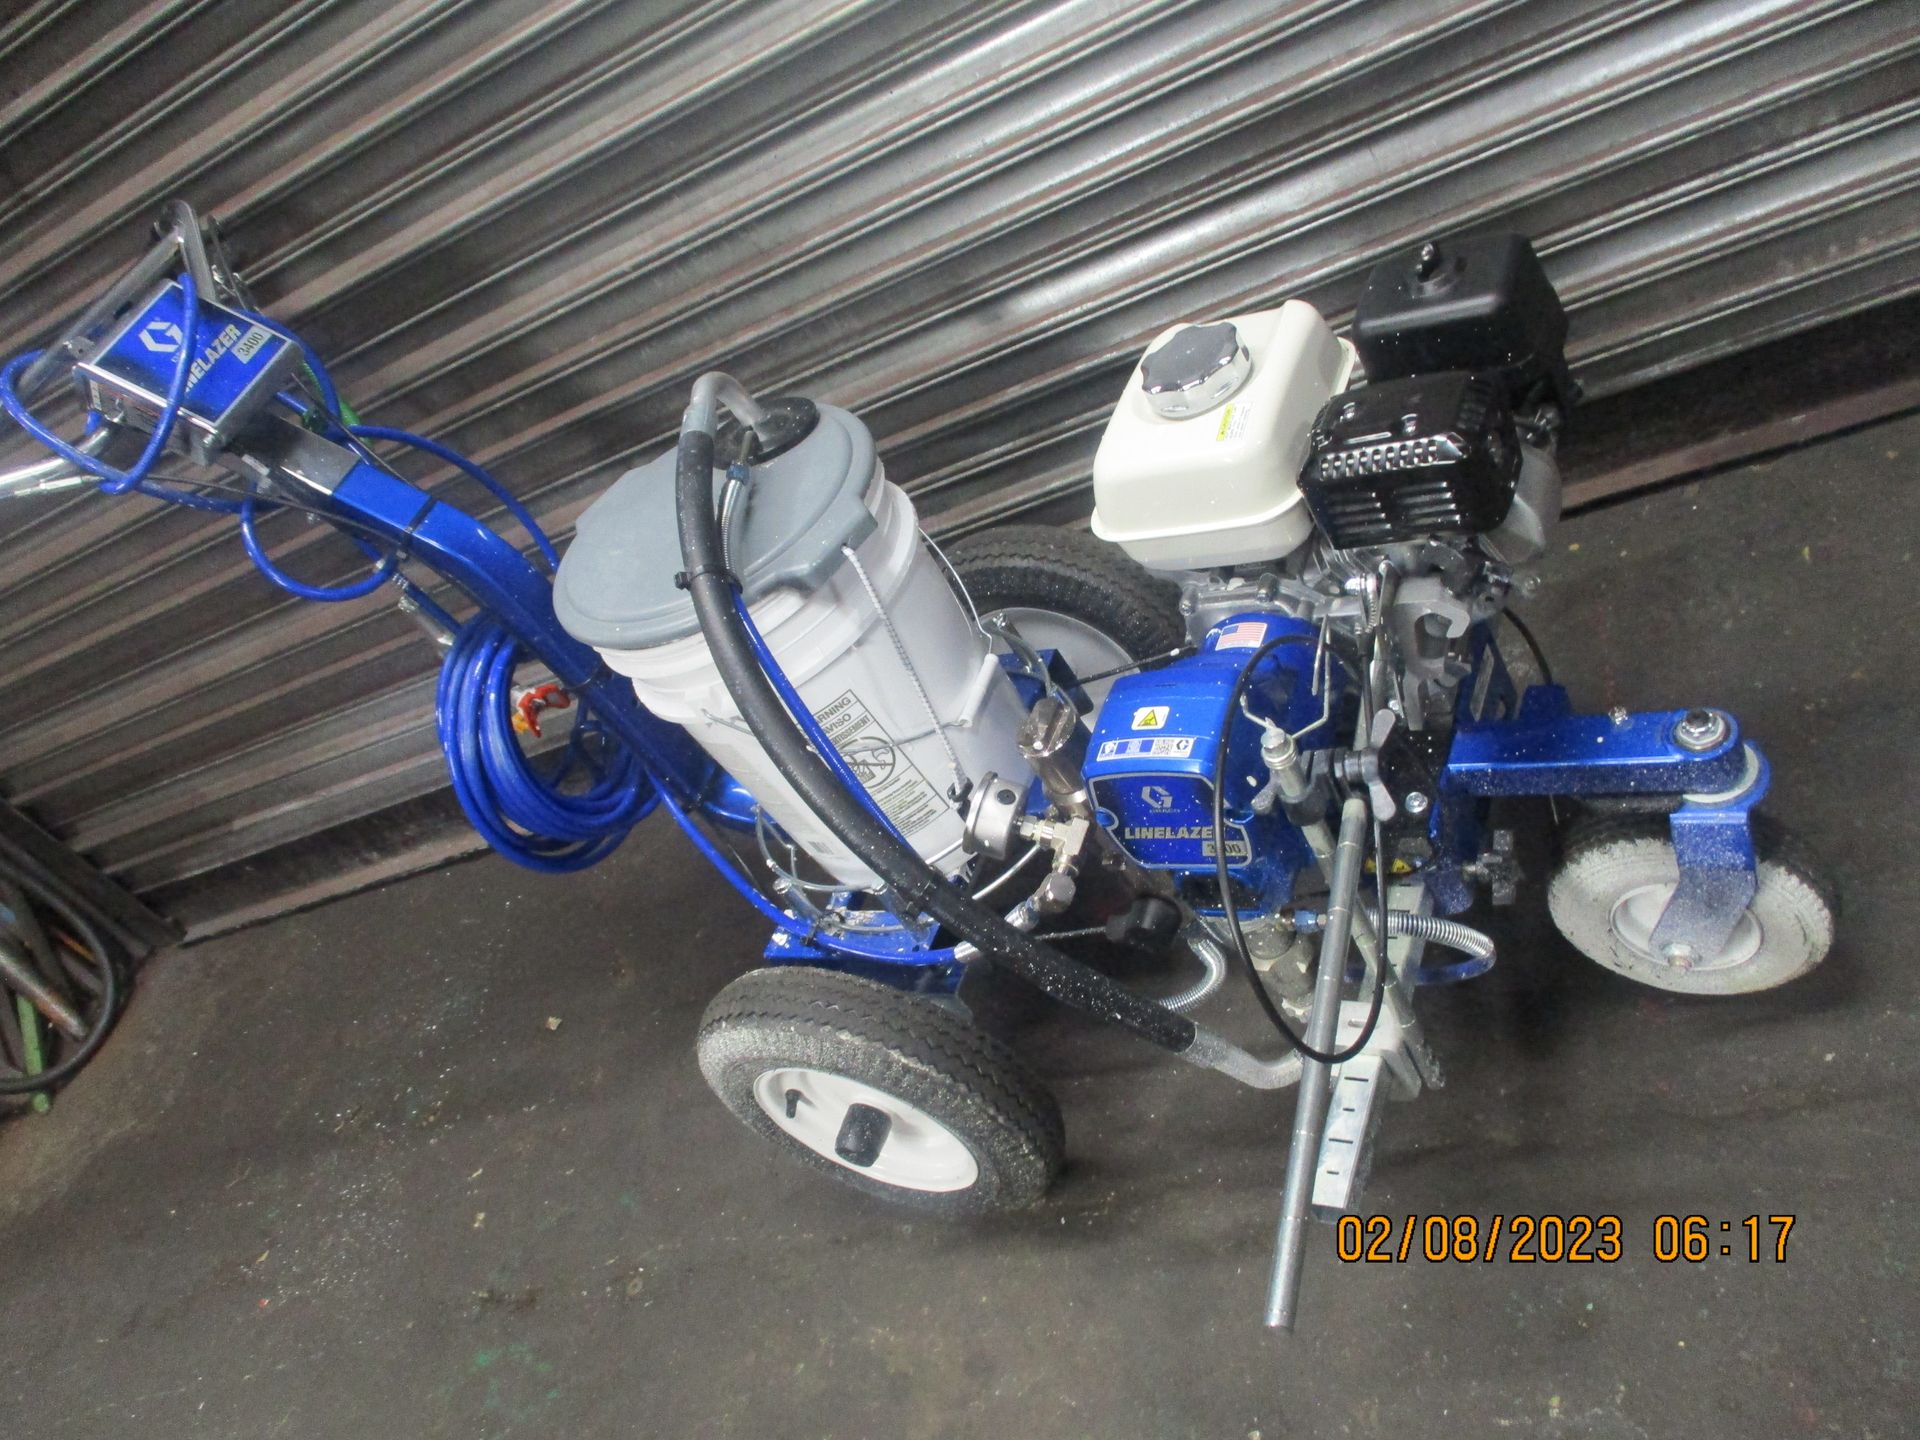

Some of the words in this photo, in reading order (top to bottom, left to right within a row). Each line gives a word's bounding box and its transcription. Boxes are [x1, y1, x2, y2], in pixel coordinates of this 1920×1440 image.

[237, 331, 264, 357] 3400
[1124, 826, 1215, 839] LINELAZE
[1206, 843, 1242, 854] 300
